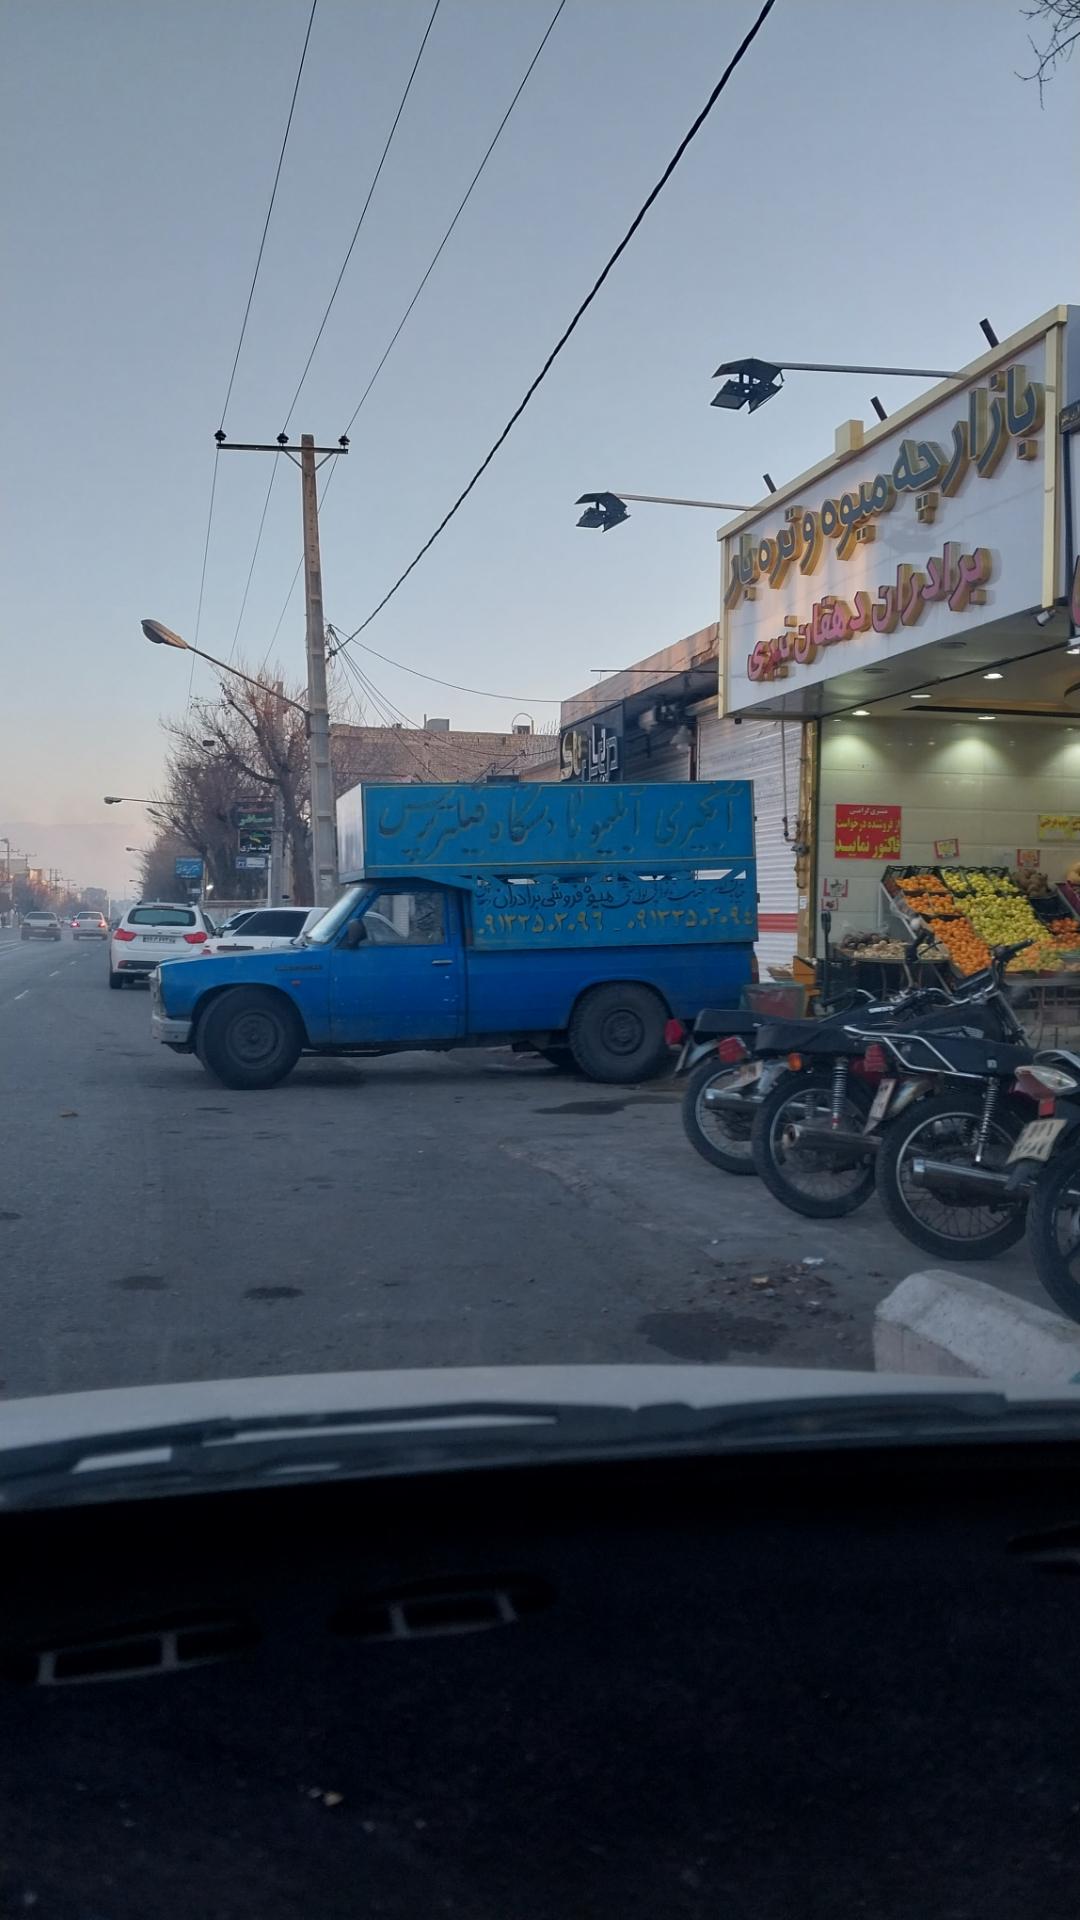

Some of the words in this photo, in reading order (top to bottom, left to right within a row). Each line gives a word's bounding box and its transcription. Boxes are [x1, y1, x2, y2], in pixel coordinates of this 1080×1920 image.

[892, 364, 1045, 523] بازارچه
[800, 510, 824, 576] و
[821, 474, 901, 560] میوه
[870, 541, 992, 634] برادران
[793, 590, 872, 665] دهقان
[489, 783, 555, 846] دستگاه
[835, 834, 870, 857] نمایید
[872, 834, 901, 858] فاکتور
[493, 884, 541, 910] برادران
[541, 882, 584, 909] فروشی
[585, 885, 615, 909] میوه
